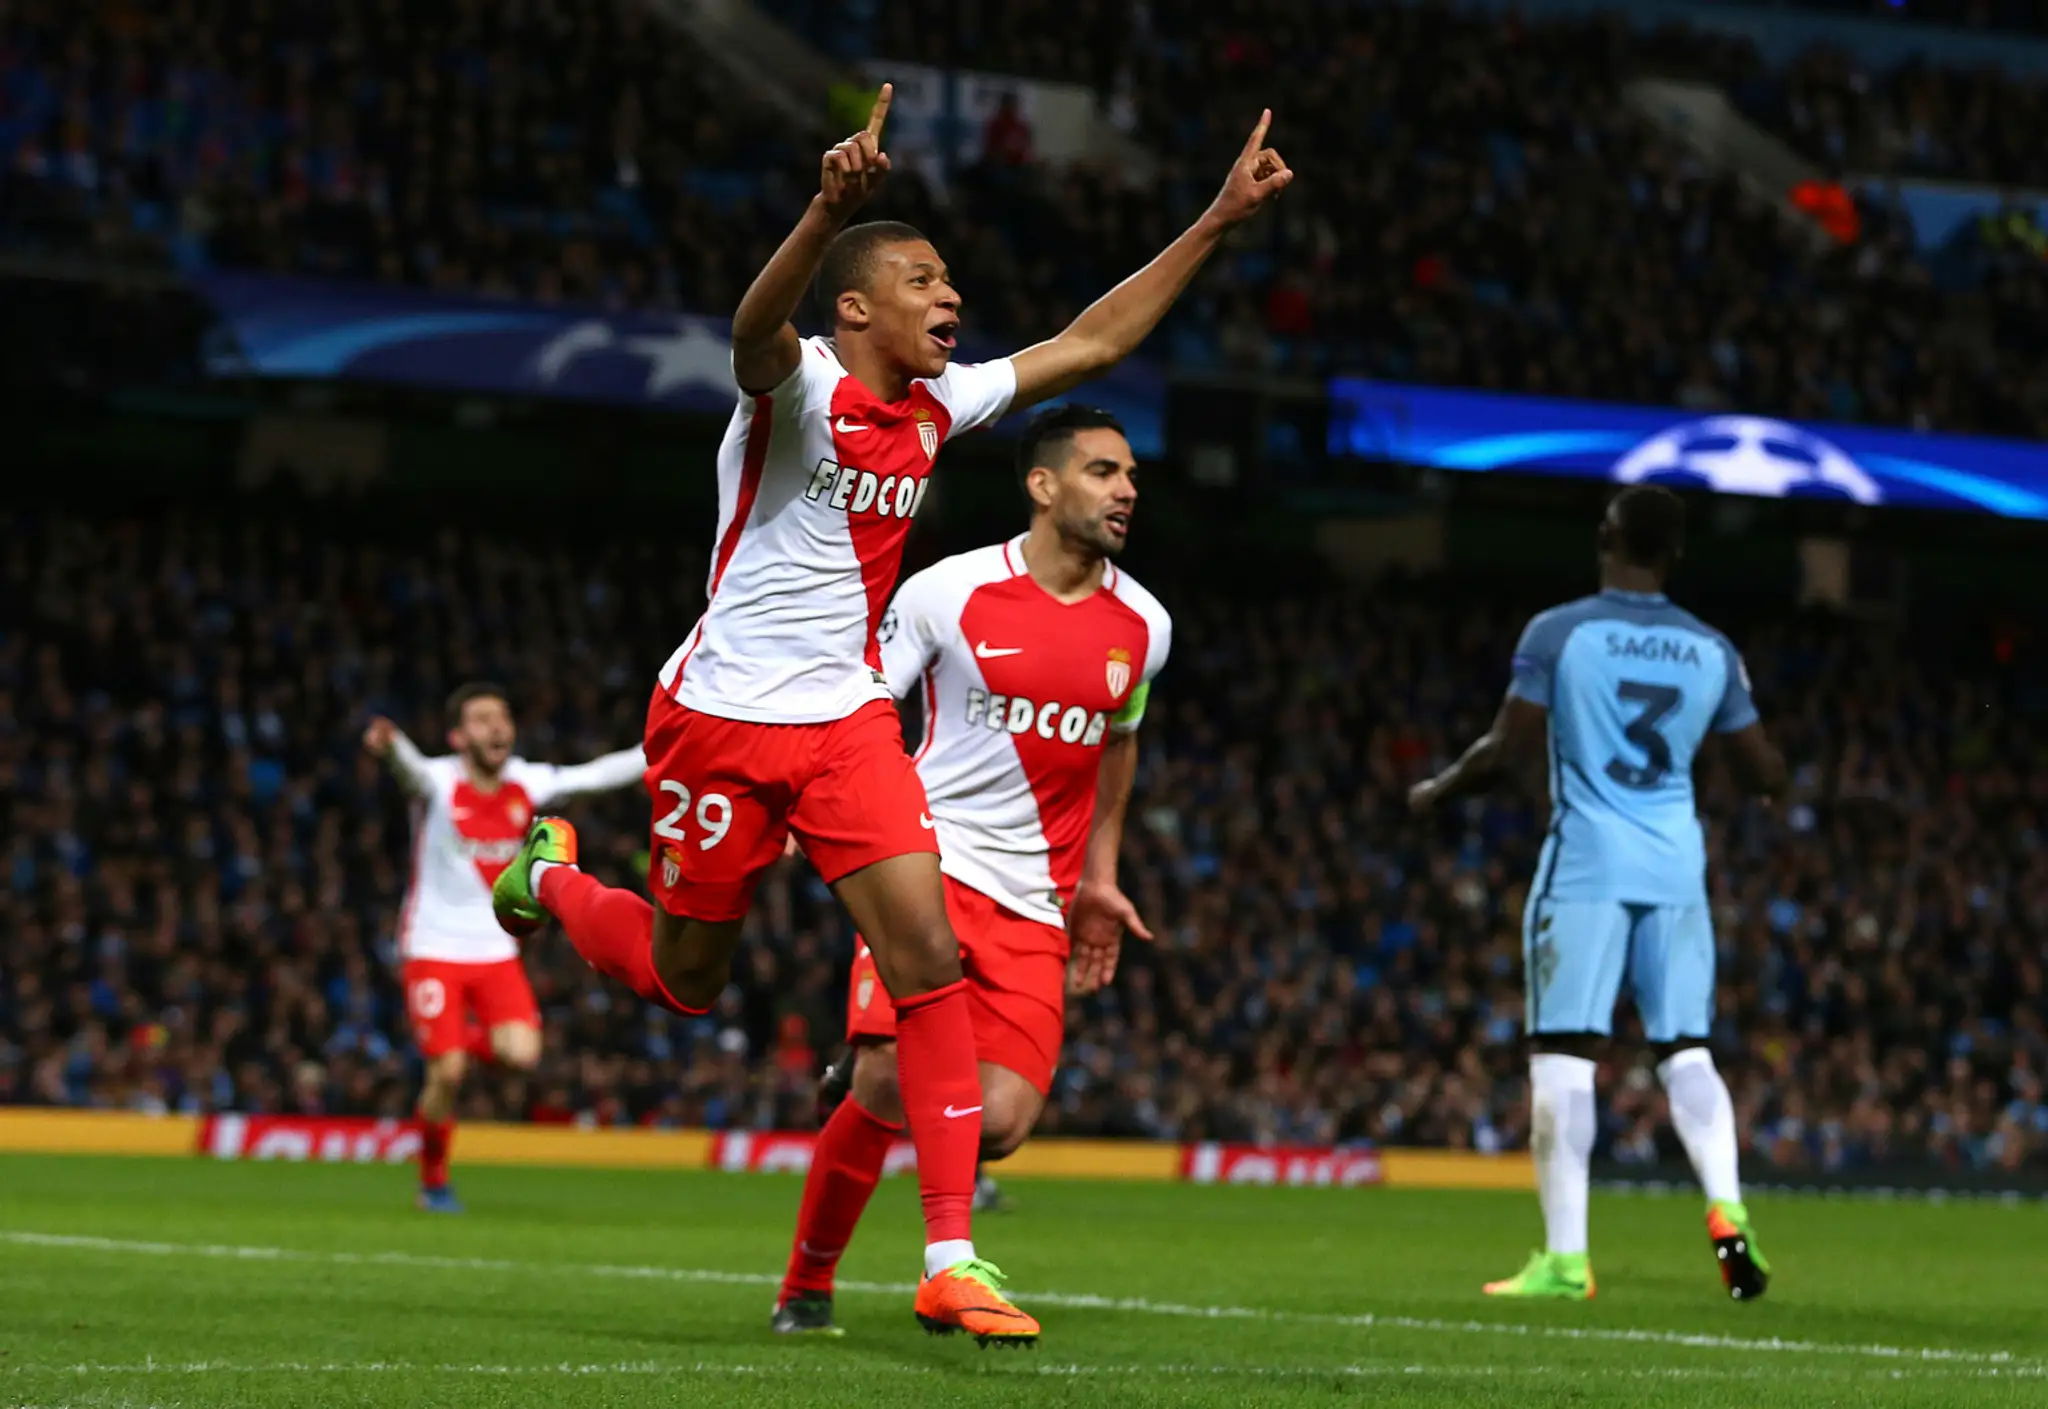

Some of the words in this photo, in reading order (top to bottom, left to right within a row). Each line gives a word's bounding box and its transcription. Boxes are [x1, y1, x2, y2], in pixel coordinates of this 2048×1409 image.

[1605, 631, 1702, 668] SAGNA
[1603, 679, 1684, 791] 3
[653, 779, 733, 851] 29
